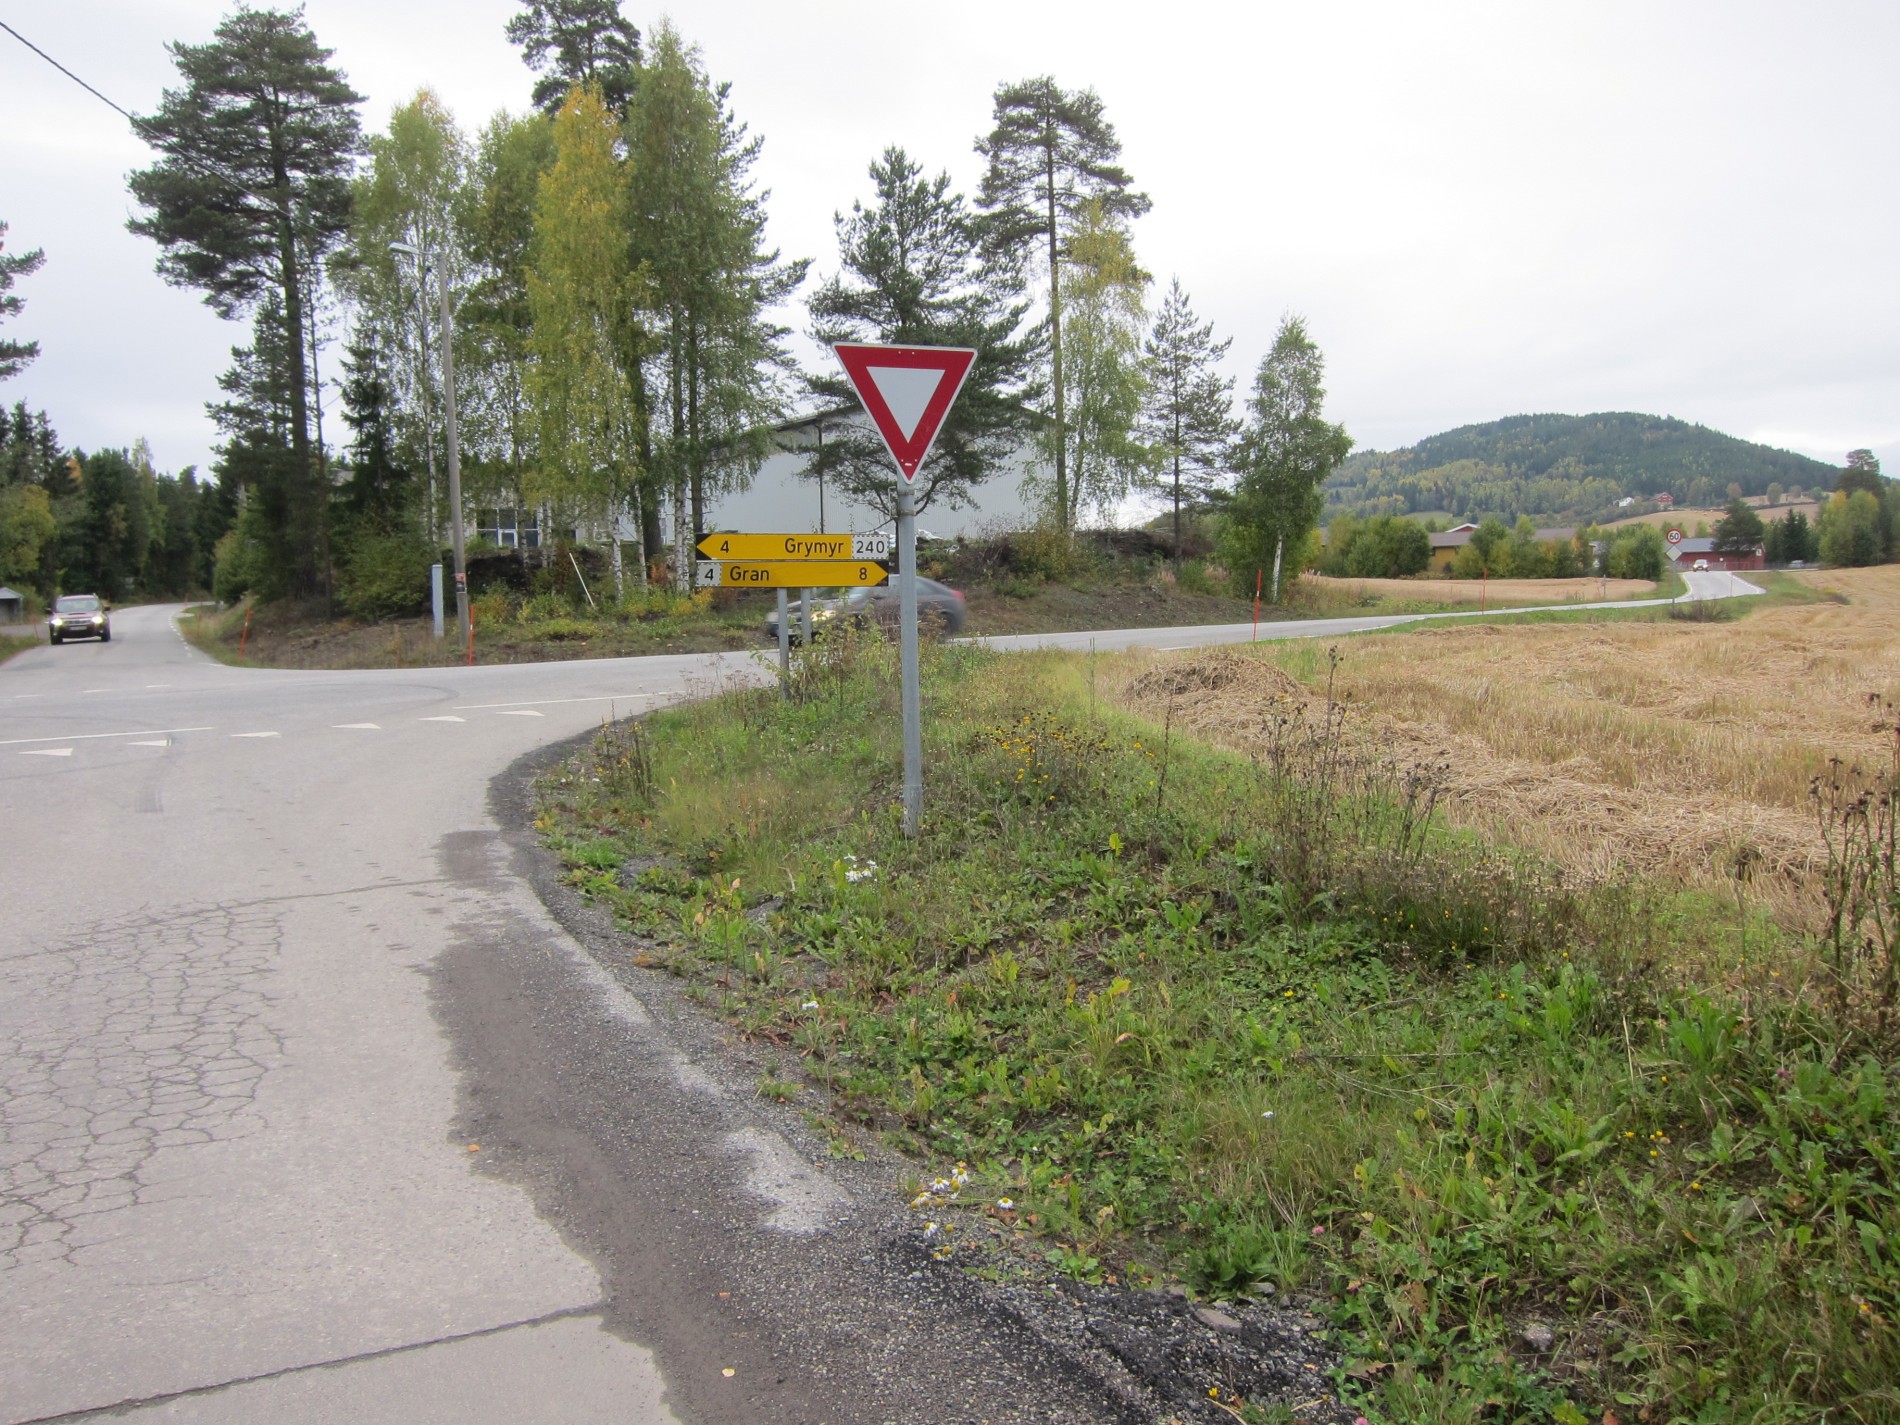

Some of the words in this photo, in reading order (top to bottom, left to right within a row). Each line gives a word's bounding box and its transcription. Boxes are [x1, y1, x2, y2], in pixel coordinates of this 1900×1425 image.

[720, 540, 730, 553] 4
[784, 537, 844, 557] Grymyr
[856, 540, 885, 554] 240
[704, 568, 714, 581] 4
[729, 565, 770, 581] Gran
[859, 567, 868, 580] 8
